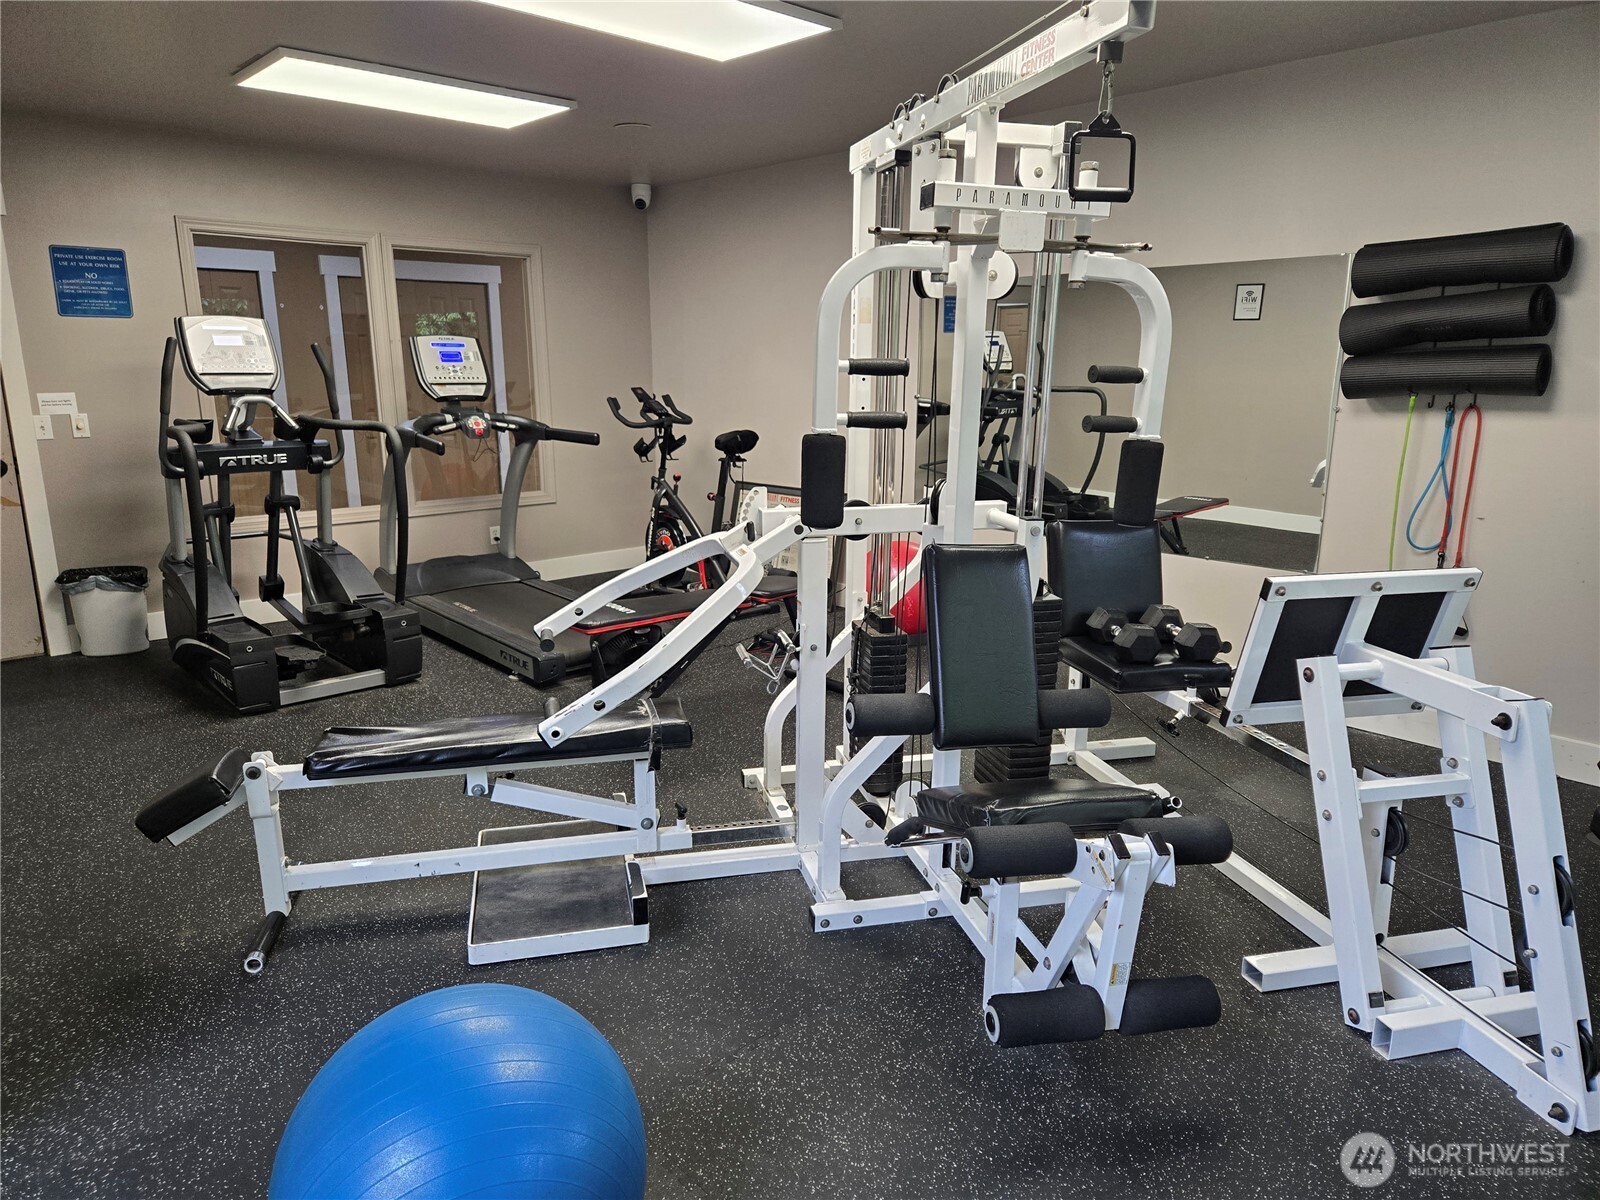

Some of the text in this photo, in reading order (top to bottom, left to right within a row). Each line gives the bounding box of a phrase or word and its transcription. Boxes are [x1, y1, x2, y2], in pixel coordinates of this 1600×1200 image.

[1021, 29, 1056, 61] FITNESS
[1020, 46, 1055, 78] CENTER
[967, 50, 1020, 106] PARAMOUNT
[237, 453, 288, 466] TRUE
[780, 496, 800, 504] FITNESS
[508, 653, 530, 671] TRUE
[215, 671, 233, 691] TRUE
